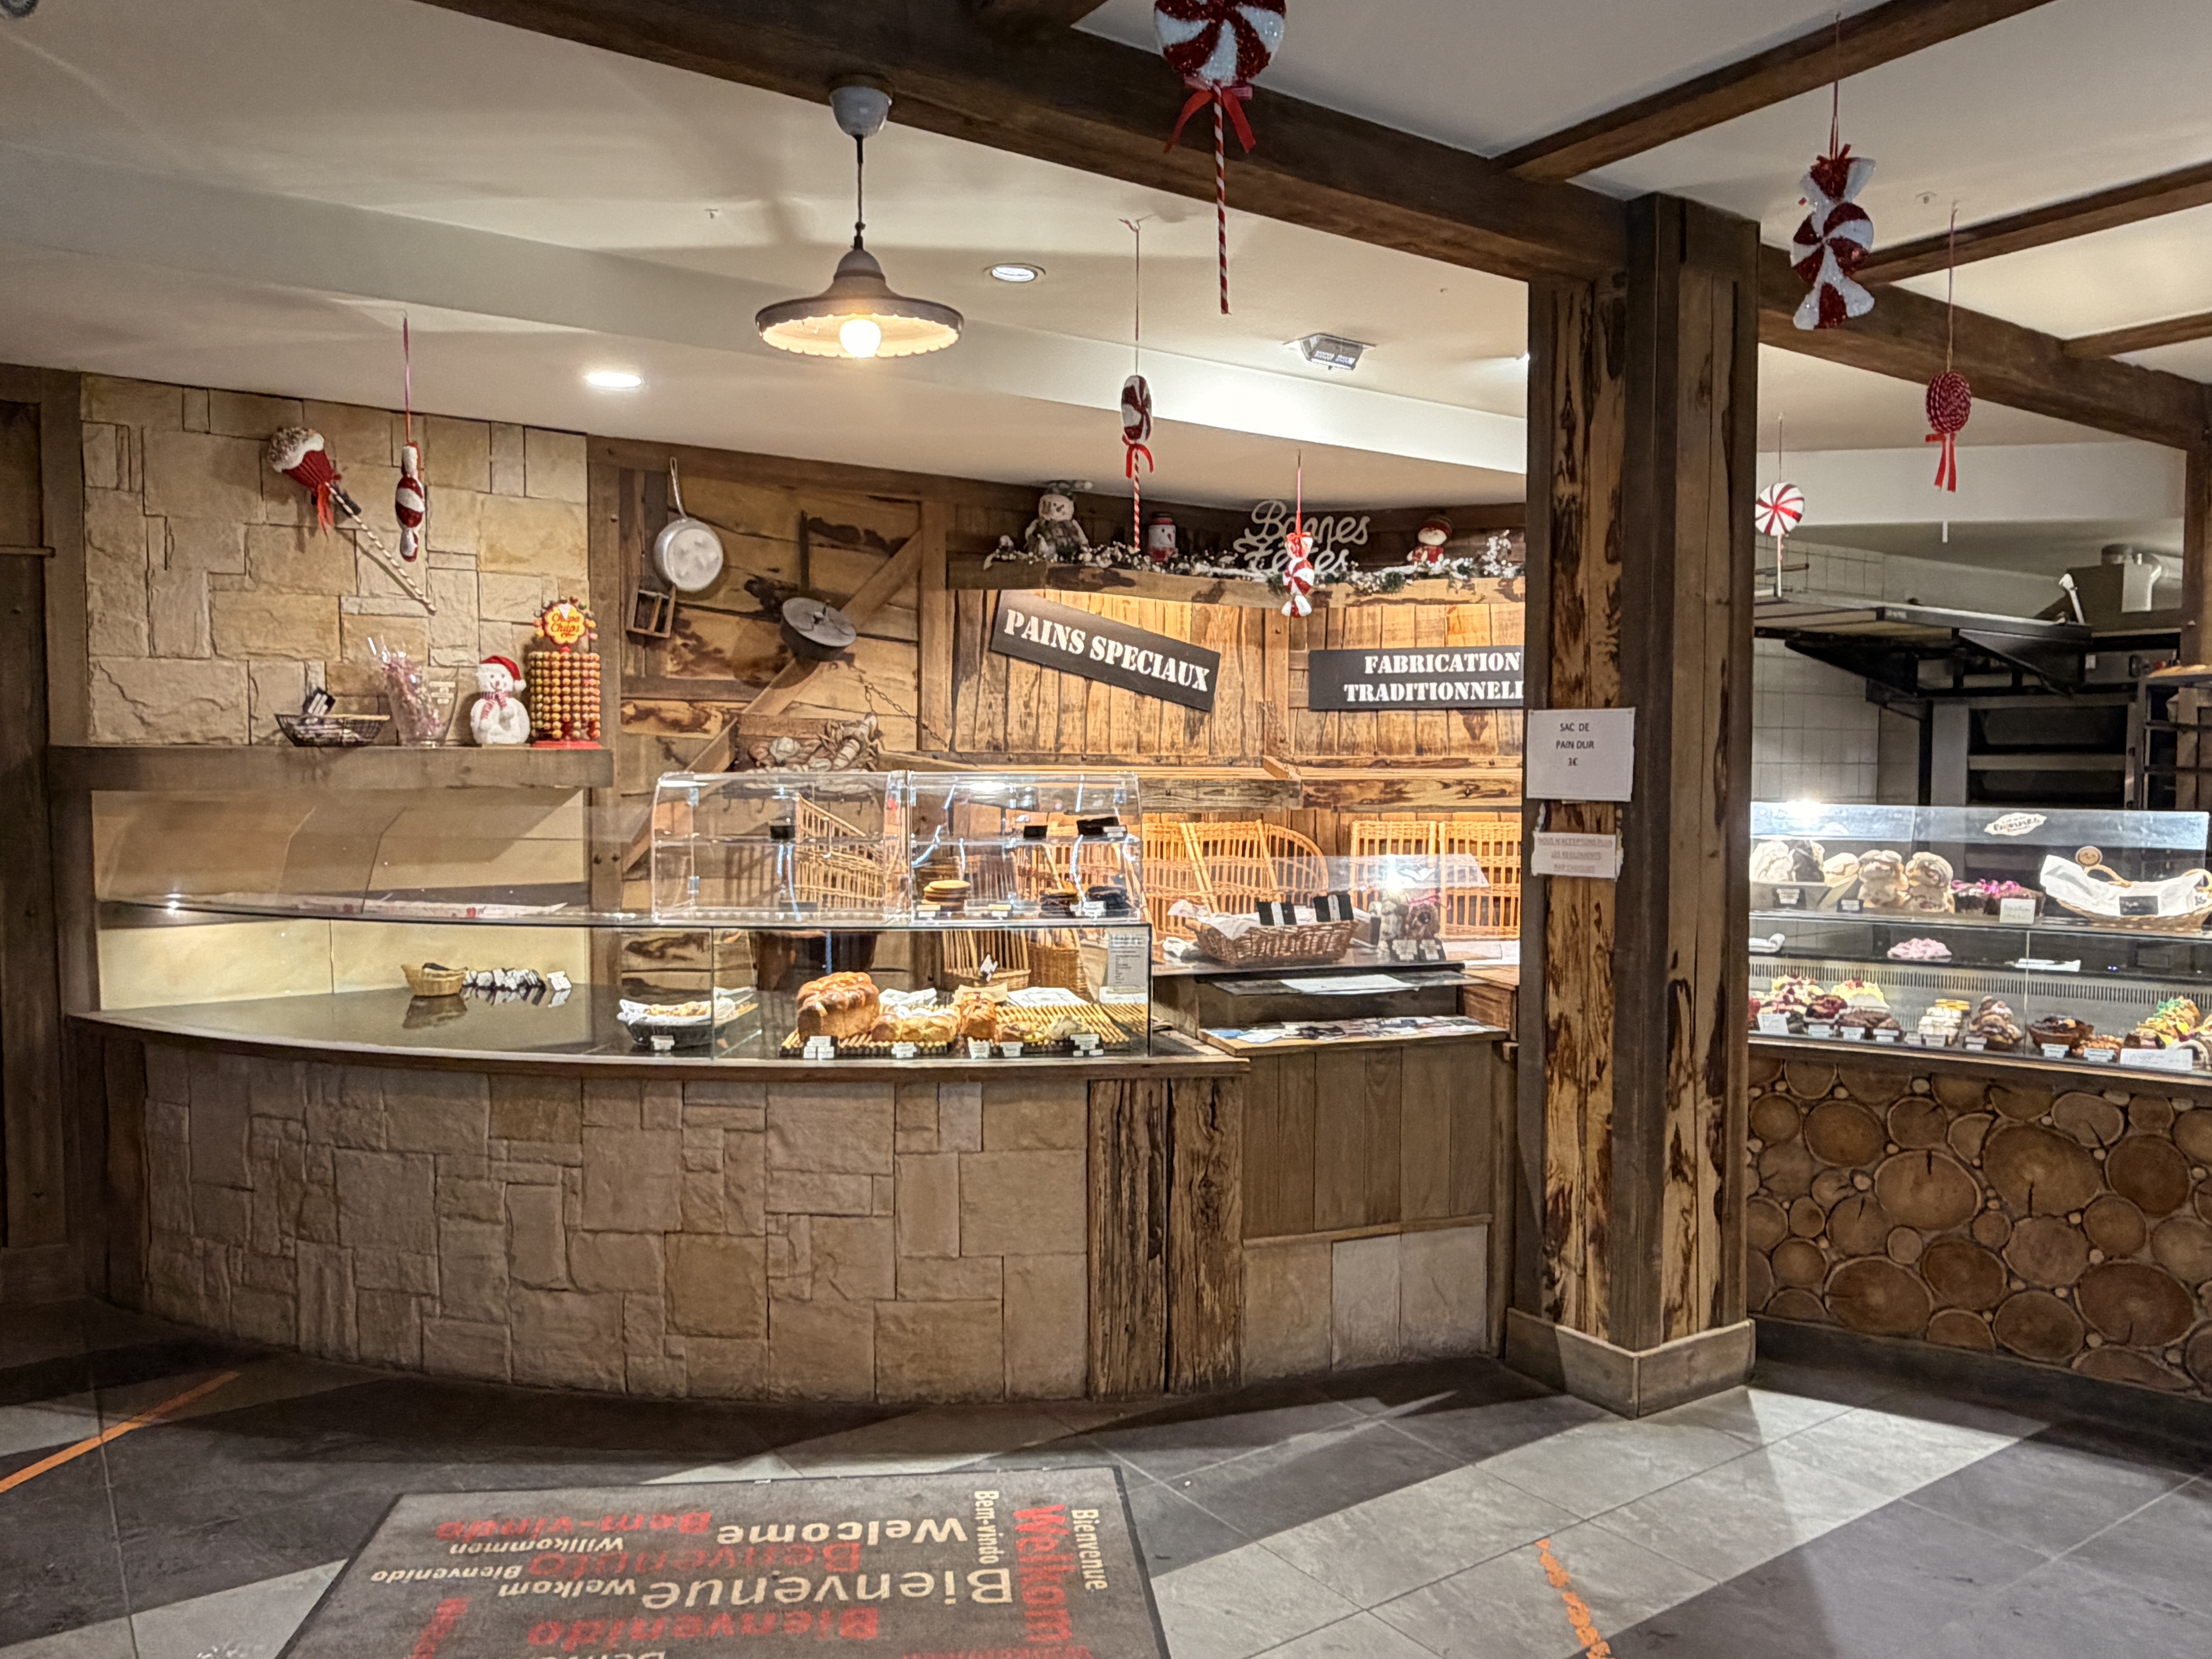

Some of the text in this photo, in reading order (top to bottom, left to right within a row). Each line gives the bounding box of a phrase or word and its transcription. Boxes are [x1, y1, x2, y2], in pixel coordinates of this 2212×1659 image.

[1004, 609, 1209, 692] PAINS SPECIAUX
[1365, 652, 1520, 674] FABRICATION
[1560, 722, 1590, 732] SAC DE
[1556, 740, 1594, 749] PAIN DUR
[435, 1511, 711, 1542] Bem-vindo
[717, 1517, 968, 1546] Welcome
[974, 1491, 1004, 1565] Bem-vindo
[449, 1537, 624, 1554] Willkommen
[1072, 1509, 1108, 1590] Bienvenue
[371, 1565, 523, 1583] Bienvenido
[528, 1543, 861, 1580] Benvenuto
[1013, 1504, 1076, 1641] Welkom
[499, 1579, 635, 1598] Welkom
[641, 1568, 1013, 1609] Bienvenue
[527, 1607, 878, 1652] Bienvenido
